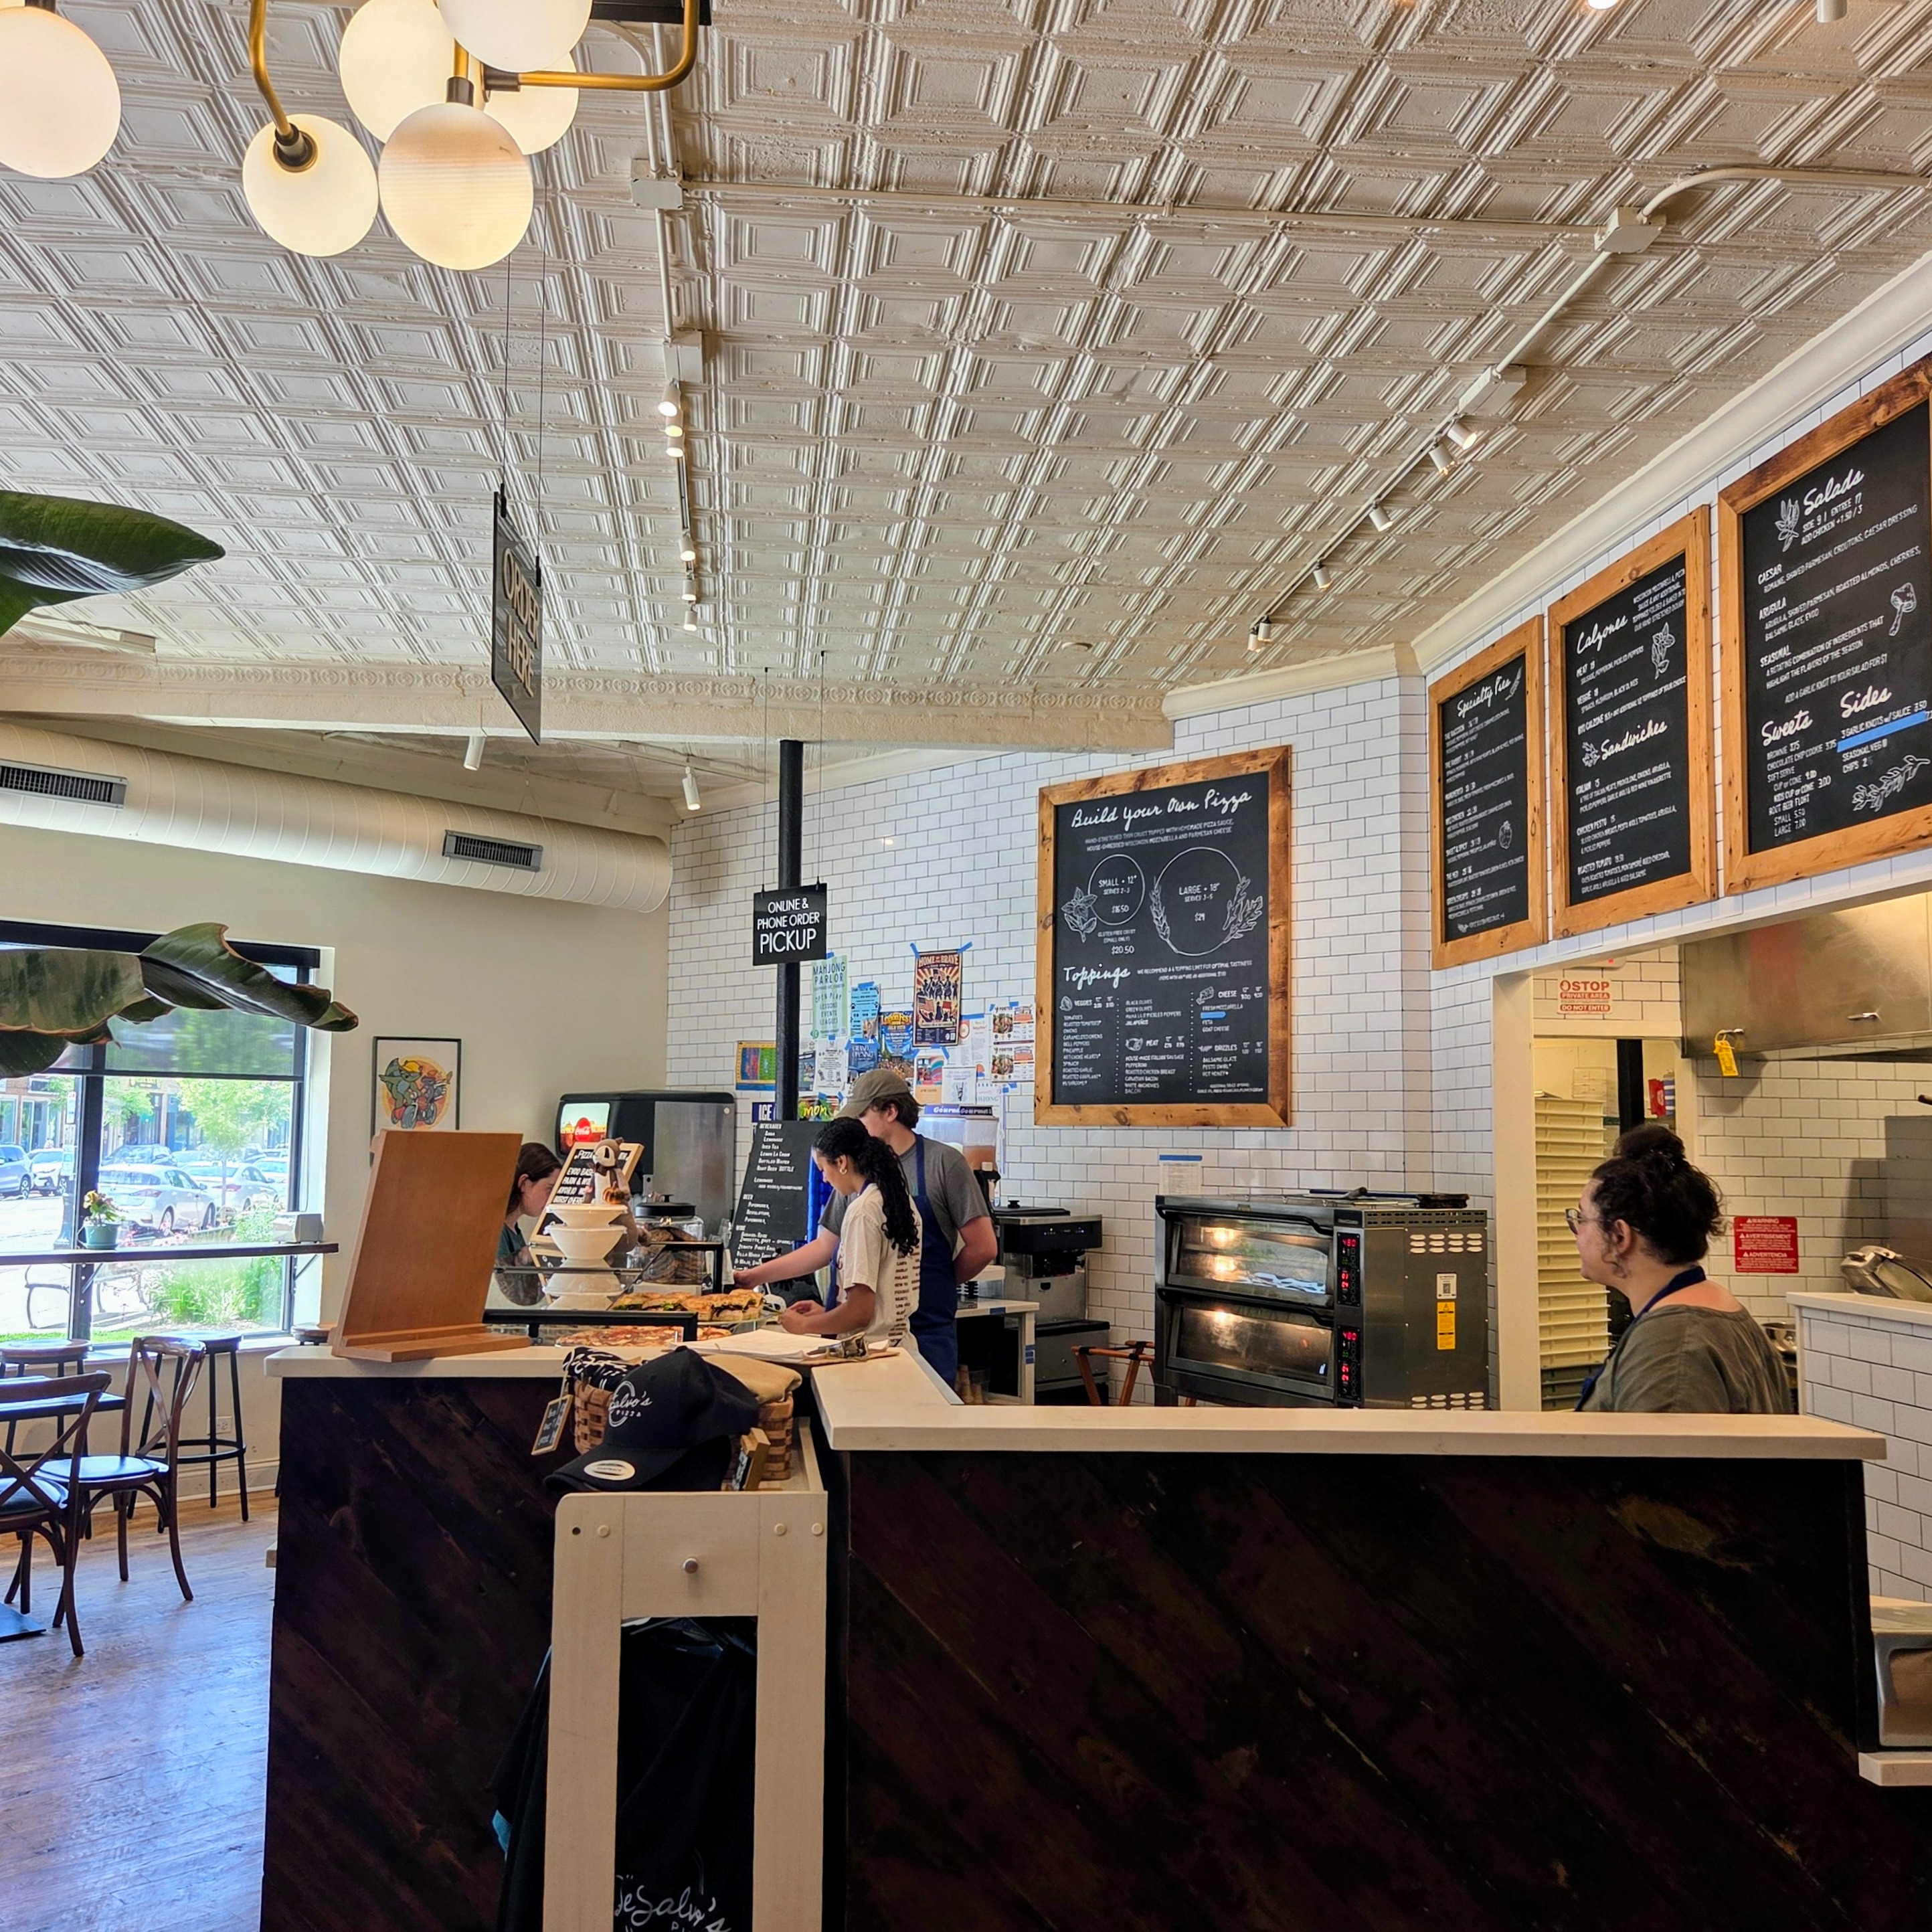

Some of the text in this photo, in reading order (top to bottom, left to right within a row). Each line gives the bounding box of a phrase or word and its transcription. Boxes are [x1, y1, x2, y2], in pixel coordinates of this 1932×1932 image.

[1803, 468, 1864, 515] Salads
[1802, 497, 1852, 533] SIDE ENTREE
[1785, 504, 1917, 581] SHAVED CAESAR DRESSING
[1801, 519, 1835, 545] ADD CHICKEN
[1757, 563, 1782, 584] CAESAR
[502, 547, 540, 649] ORDER
[1759, 596, 1786, 620] ARUGULA
[1787, 574, 1862, 619] SHAVED ROASTED
[1576, 615, 1628, 654] Calzones
[1765, 608, 1819, 642] BALSAMIC EVOO
[1791, 615, 1884, 665] COMBINATION OF INGREDIENTS THAT
[507, 608, 534, 697] HERE
[1759, 644, 1791, 667] SEASONAL
[1765, 638, 1863, 689] HIGHLIGHT THE FLAVORS OF THE SEASON
[1784, 656, 1880, 703] ADD GARLIC KNOT TO YOUR SALAD FOR
[1457, 676, 1511, 718] Specialty Pies
[1840, 685, 1892, 718] Sides
[1761, 709, 1813, 746] Sweets
[1845, 705, 1911, 737] GARLIC KNOTS SAUCE
[1600, 719, 1667, 760] Sandwiches
[1766, 745, 1787, 760] BROWNIE
[1767, 743, 1823, 771] CHOCOLATE CHIP COOKIE
[1842, 745, 1870, 762] SEASONAL
[1767, 765, 1795, 783] SOFT SERVE
[1842, 760, 1859, 773] CHIPS
[1773, 774, 1802, 792] CUP CONE
[1784, 781, 1814, 799] CUP CONE
[1071, 788, 1252, 831] Build Your Own Pizza
[1768, 793, 1810, 816] ROOT BEER FLOAT
[1773, 813, 1791, 826] SMALL
[1773, 822, 1791, 837] LARGE
[1098, 877, 1119, 887] SMALL
[1178, 884, 1201, 895] LARGE
[768, 897, 808, 913] ONLINE &
[1184, 894, 1202, 902] SERVES
[758, 912, 820, 930] PHONE ORDER
[760, 928, 816, 954] PICKUP
[813, 962, 845, 974] MAHJONG
[919, 954, 958, 967] HOME BRAVE
[814, 973, 843, 984] PARLOR
[1063, 963, 1130, 990] Toppings
[1572, 981, 1609, 990] STOP
[1217, 990, 1237, 998] CHEESE
[1214, 1043, 1237, 1051] DRIZZLES
[759, 1104, 772, 1121] ICE
